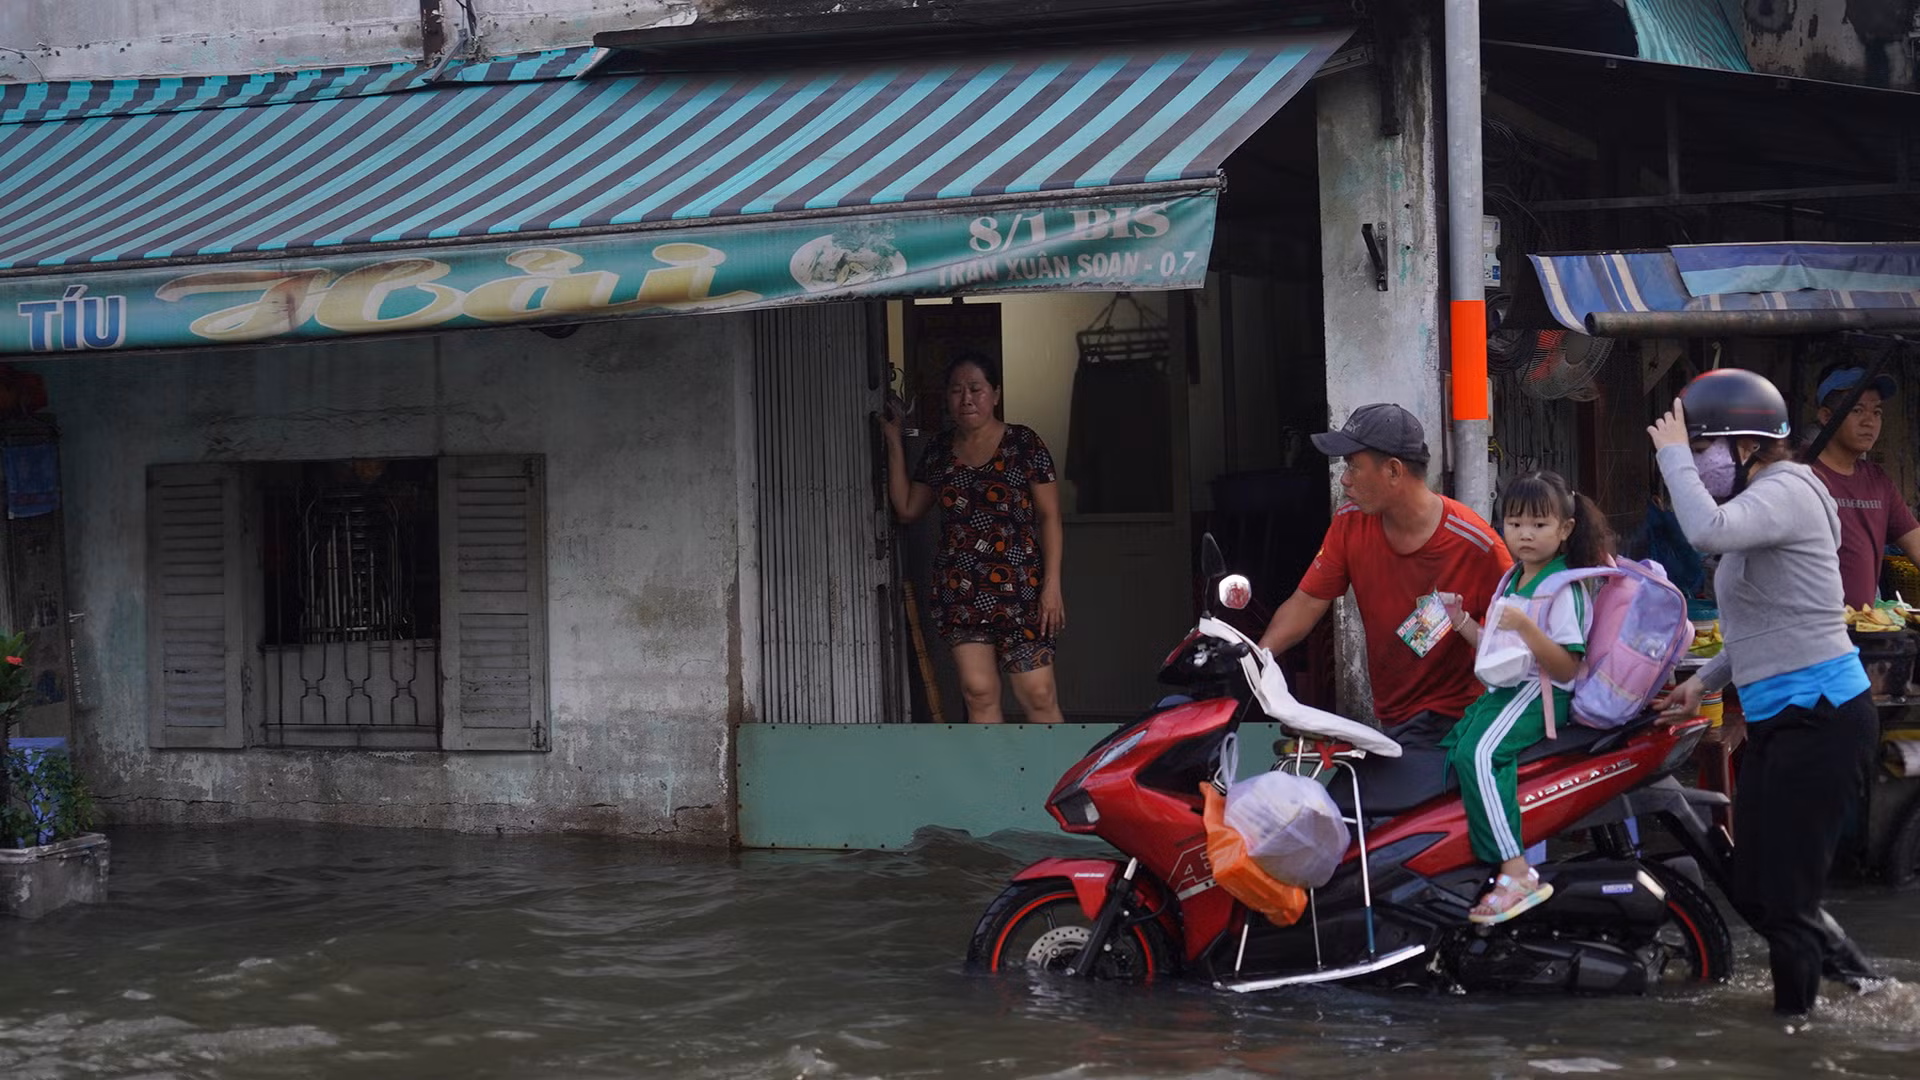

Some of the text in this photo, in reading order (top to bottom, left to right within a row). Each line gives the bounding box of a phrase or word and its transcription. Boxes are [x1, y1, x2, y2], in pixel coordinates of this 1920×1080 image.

[969, 203, 1171, 252] 8/1 BIS
[1006, 251, 1070, 280] XUÂN
[18, 284, 126, 352] TÍU
